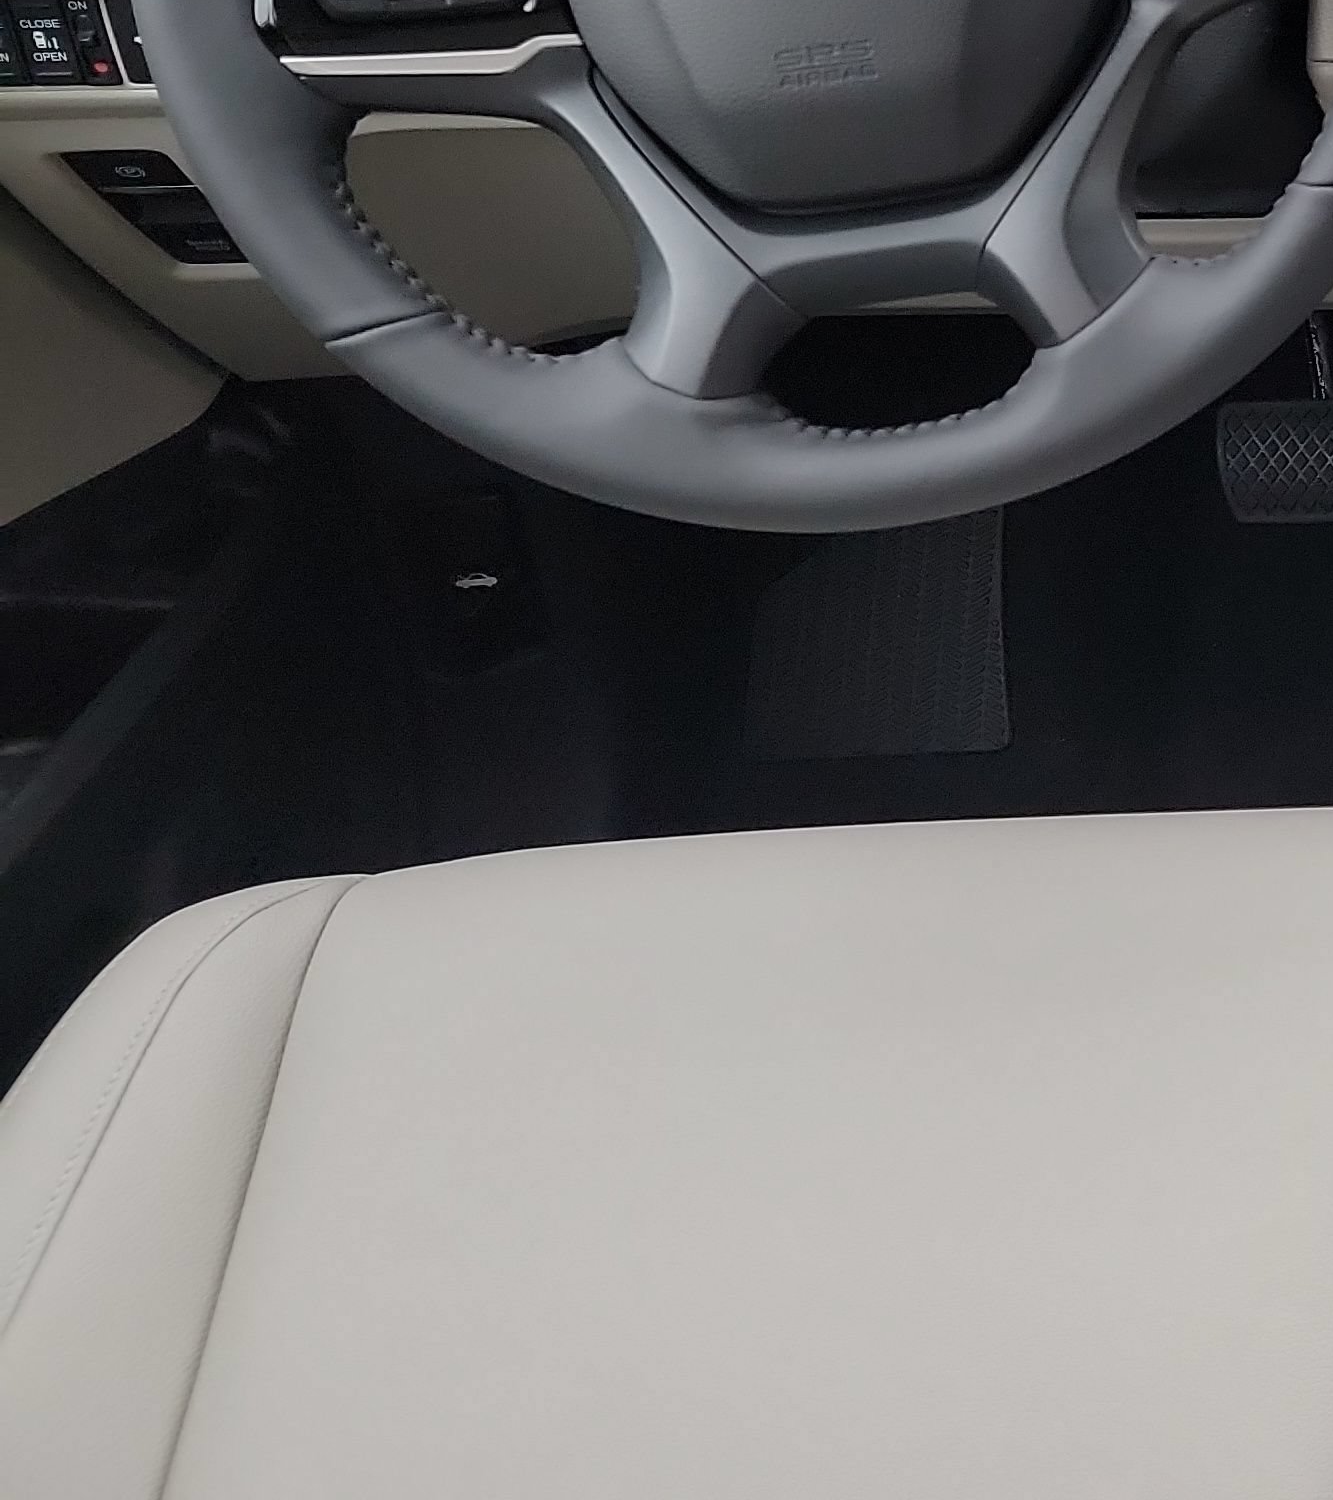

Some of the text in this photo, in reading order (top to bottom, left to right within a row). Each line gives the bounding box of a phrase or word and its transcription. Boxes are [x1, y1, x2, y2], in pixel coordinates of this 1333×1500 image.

[67, 0, 88, 11] ON
[19, 19, 61, 29] CLOSE
[33, 52, 68, 62] OPEN
